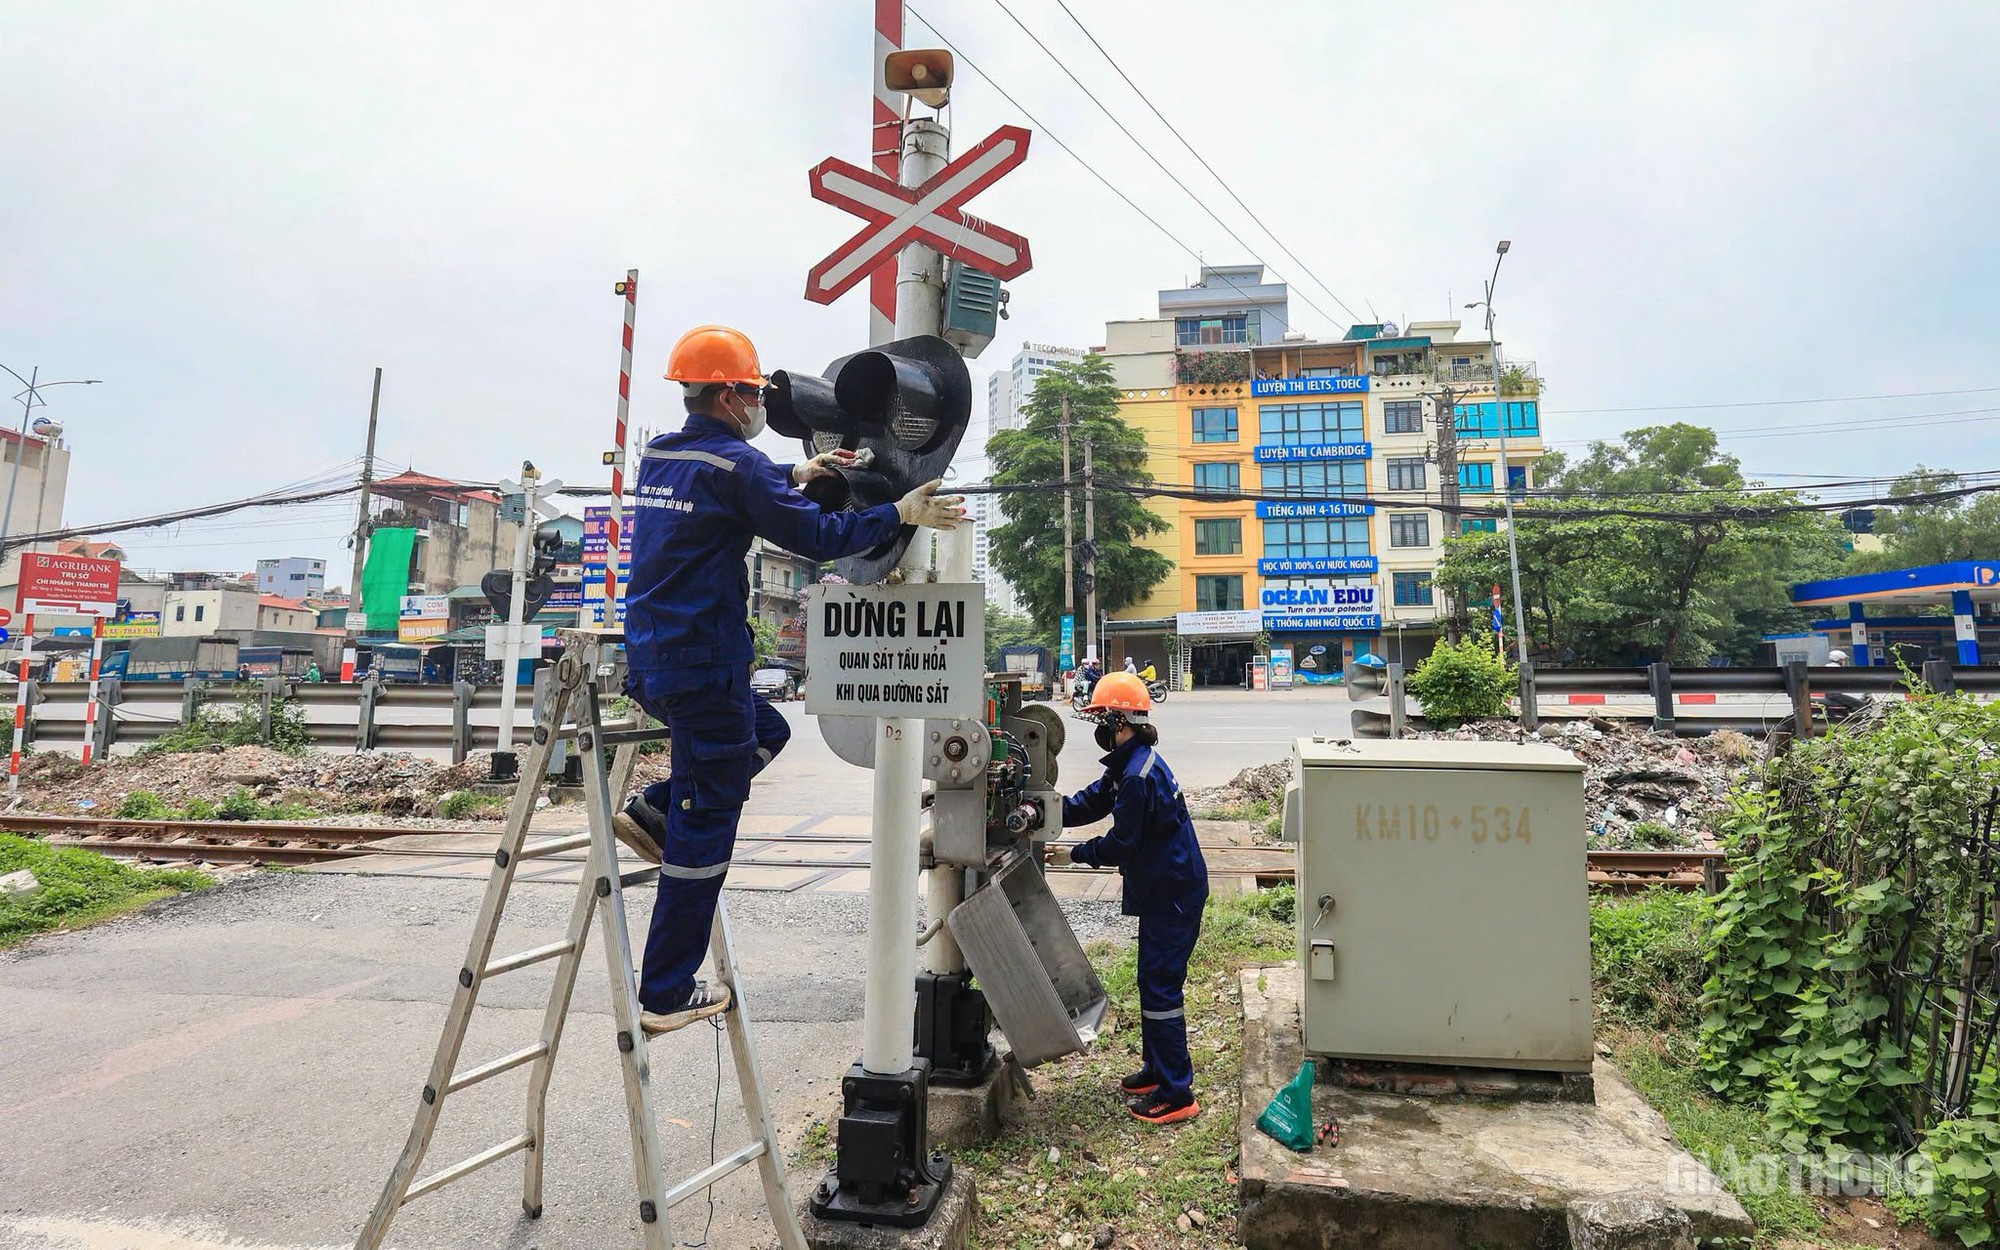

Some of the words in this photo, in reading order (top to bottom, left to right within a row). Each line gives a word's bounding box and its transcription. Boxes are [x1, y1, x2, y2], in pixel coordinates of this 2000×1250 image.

[1032, 343, 1057, 354] TECCO
[1257, 380, 1286, 394] LUYỆN
[1289, 381, 1304, 392] THI
[1307, 380, 1335, 391] IELTS,
[1335, 378, 1362, 389] TOEIC
[1260, 446, 1289, 460] LUYỆN
[1292, 447, 1307, 457] THI
[1310, 445, 1366, 457] CAMBRIDGE
[1266, 502, 1294, 517] TIẾNG
[1296, 505, 1316, 515] ANH
[1319, 504, 1340, 515] 4-16
[52, 561, 112, 573] AGRIBANK
[1263, 562, 1278, 572] HỌC
[1279, 559, 1292, 570] VỚI
[1294, 561, 1314, 570] 100%
[1315, 561, 1326, 570] GV
[1327, 558, 1348, 569] NƯỚC
[1349, 558, 1373, 569] NGOÀI
[1262, 589, 1328, 605] OCEAN
[1333, 588, 1374, 604] EDU
[1287, 606, 1304, 614] Turn
[1337, 605, 1373, 614] potential
[824, 592, 906, 638] DỪNG
[917, 601, 965, 645] LẠI
[1264, 617, 1275, 630] HỆ
[1276, 616, 1304, 628] THỐNG
[1305, 619, 1322, 627] ANH
[1323, 616, 1341, 627] NGỮ
[1342, 616, 1364, 627] QUỐC
[1366, 615, 1376, 627] TẾ
[839, 652, 869, 671] QUAN
[873, 647, 894, 670] SÁT
[898, 647, 919, 670] TẦU
[923, 645, 947, 671] HỎA
[836, 683, 854, 701] KHI
[857, 684, 880, 703] QUA
[883, 680, 923, 703] ĐƯỜNG
[926, 678, 949, 704] SẮT
